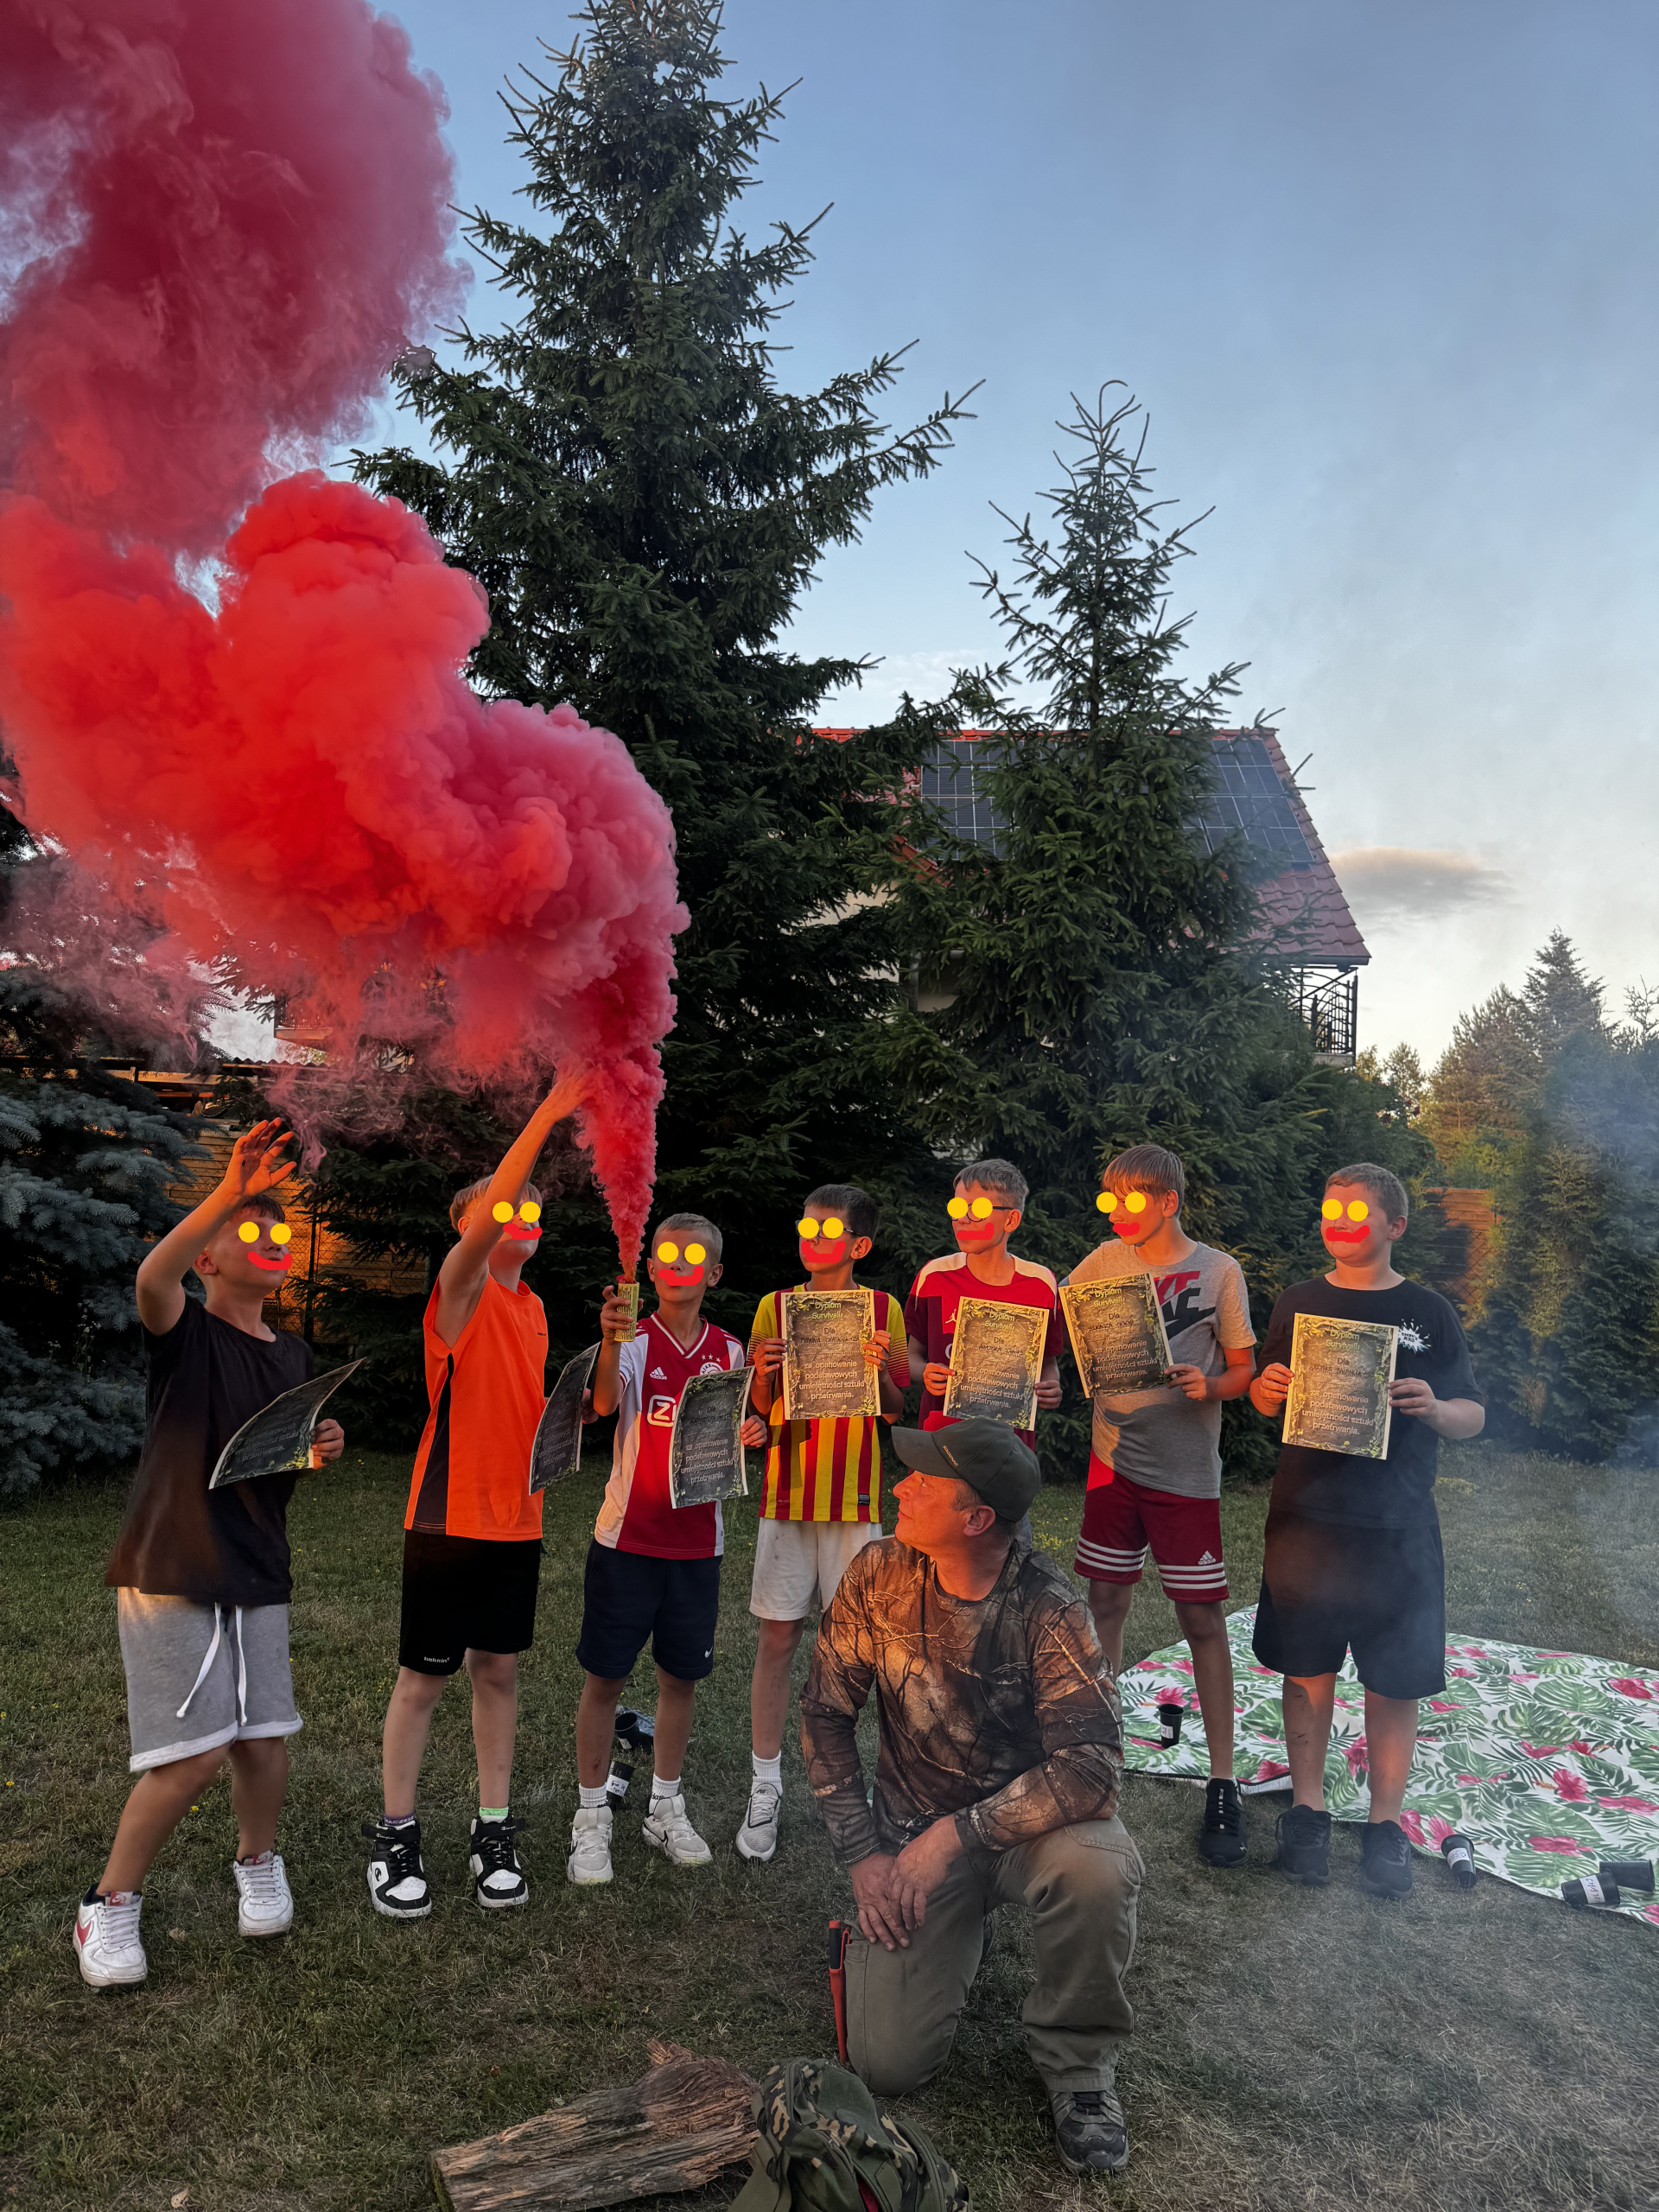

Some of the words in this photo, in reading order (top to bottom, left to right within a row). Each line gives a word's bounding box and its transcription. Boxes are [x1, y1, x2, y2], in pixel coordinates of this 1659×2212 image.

[1095, 1287, 1122, 1298] Dyplom
[815, 1302, 842, 1311] Dyplom
[989, 1312, 1014, 1322] Dyplom
[1331, 1330, 1360, 1340] Dyplom
[1106, 1339, 1147, 1352] opanowanie
[1097, 1349, 1149, 1363] podstawowych
[816, 1360, 857, 1370] opanowanie
[805, 1370, 857, 1381] podstawowych
[980, 1367, 1020, 1380] opanowanie
[968, 1375, 1018, 1389] podstawowych
[1324, 1390, 1369, 1403] opanowanie
[1310, 1400, 1367, 1414] podstawowych
